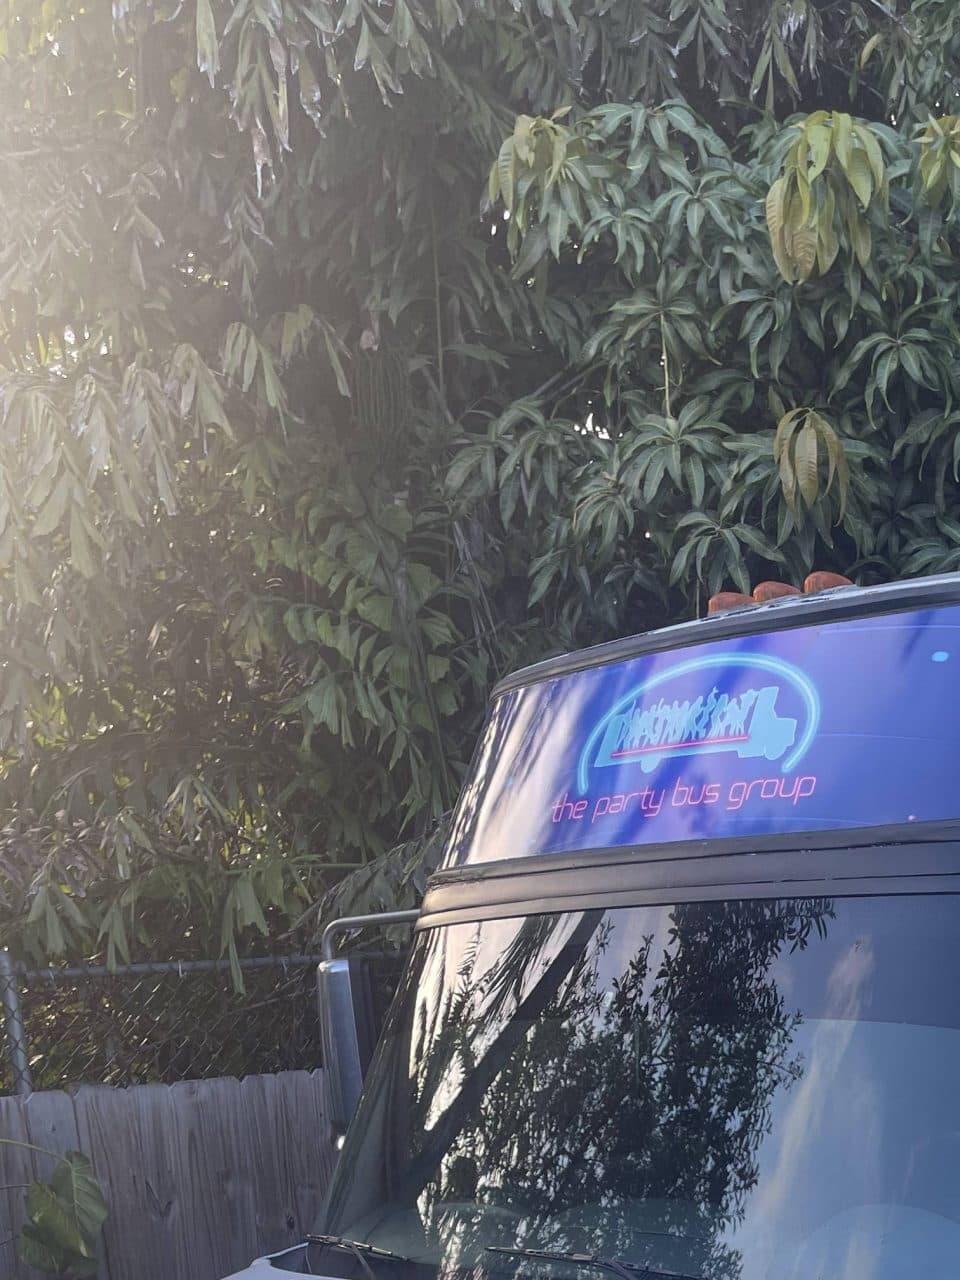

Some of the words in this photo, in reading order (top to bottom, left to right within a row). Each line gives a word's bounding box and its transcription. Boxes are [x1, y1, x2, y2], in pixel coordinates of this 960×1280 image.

[552, 792, 588, 822] the
[592, 785, 665, 823] party
[671, 776, 721, 807] bus
[726, 776, 817, 810] group
